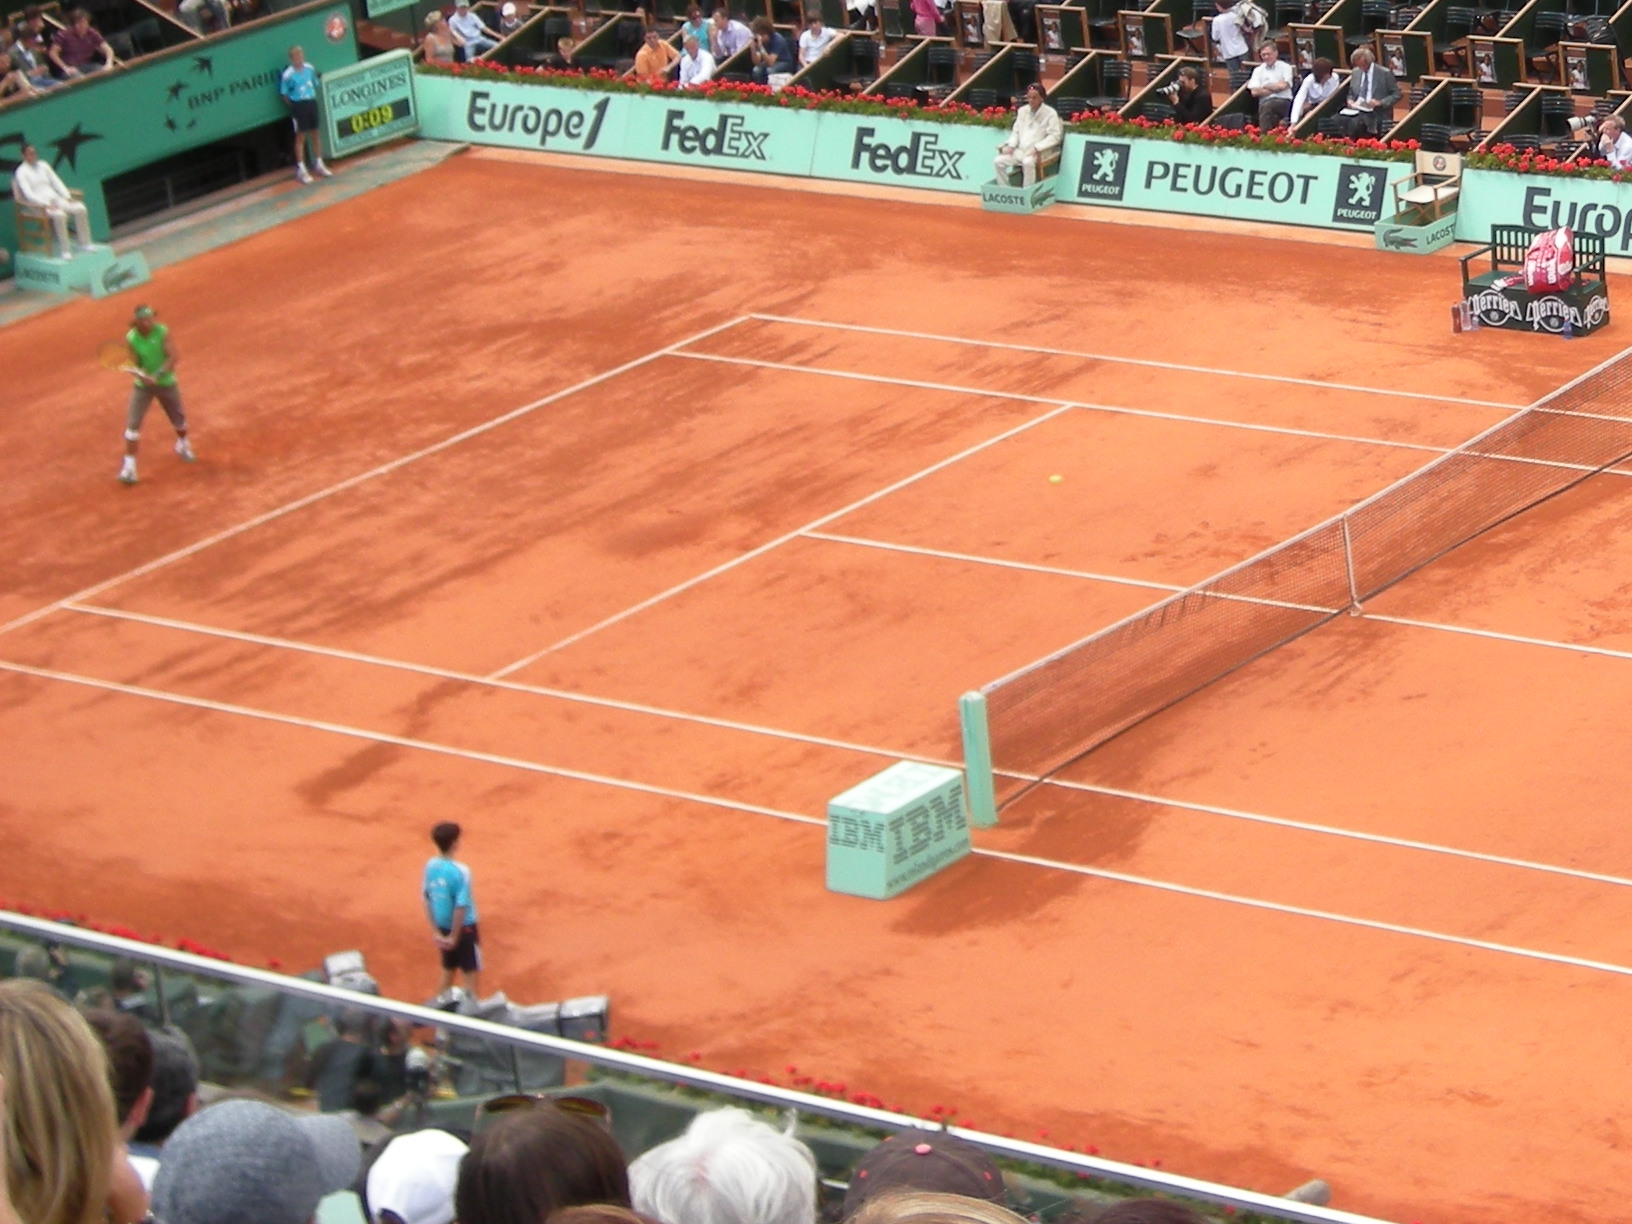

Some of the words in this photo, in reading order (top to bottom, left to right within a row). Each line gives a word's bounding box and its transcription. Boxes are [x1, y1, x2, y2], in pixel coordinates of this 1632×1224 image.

[187, 86, 224, 110] BNP
[330, 73, 407, 108] LONGINES
[351, 103, 393, 133] 0:09
[661, 109, 769, 160] FedEx
[851, 126, 966, 180] FedEx
[1082, 183, 1120, 196] PEUGEOT
[1144, 160, 1318, 205] PEUGEOT
[983, 192, 1025, 206] LACOSTE
[1337, 208, 1377, 221] PEUGEOT
[1426, 223, 1455, 244] LACOST
[1468, 293, 1522, 321] Perrier
[1526, 299, 1582, 331] Perrier
[829, 814, 885, 853] IBM
[889, 783, 967, 866] IBM
